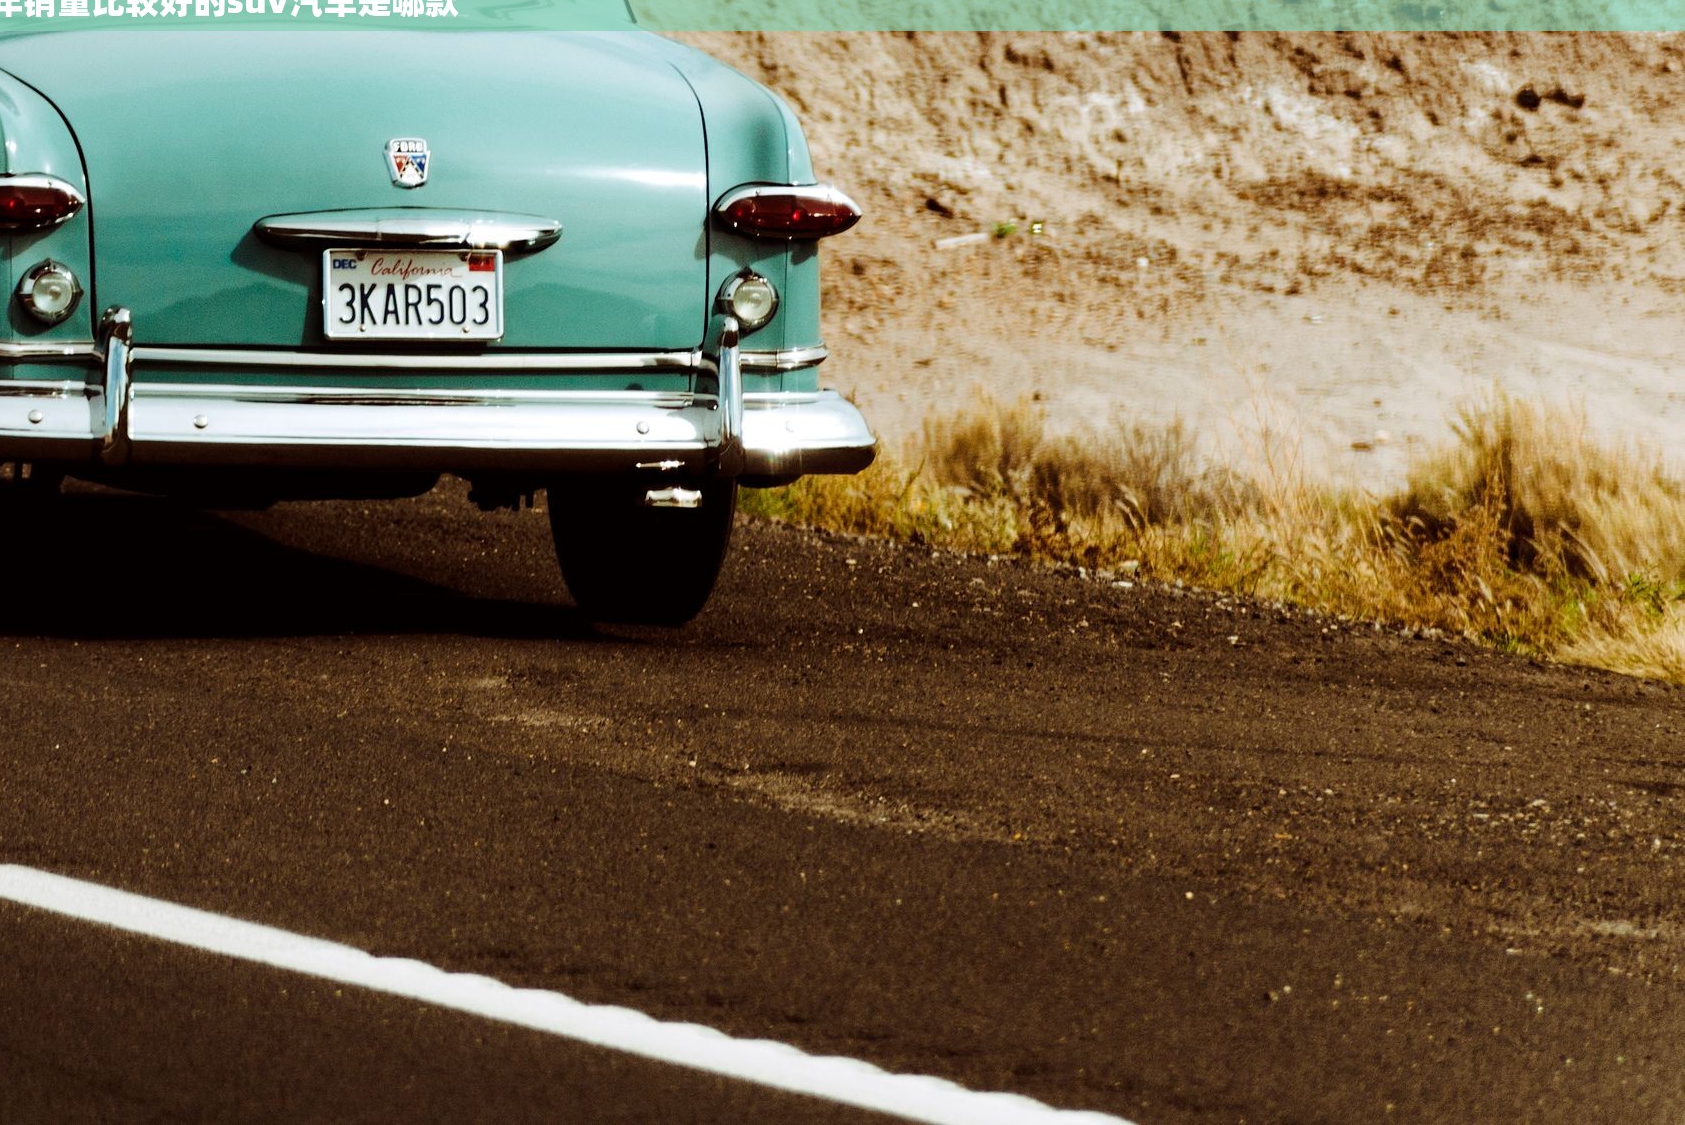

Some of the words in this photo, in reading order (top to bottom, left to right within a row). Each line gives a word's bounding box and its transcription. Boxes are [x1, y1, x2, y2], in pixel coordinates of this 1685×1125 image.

[393, 140, 424, 153] FORD
[332, 258, 358, 270] DEC
[370, 257, 462, 281] California
[338, 282, 490, 326] 3KAR503
